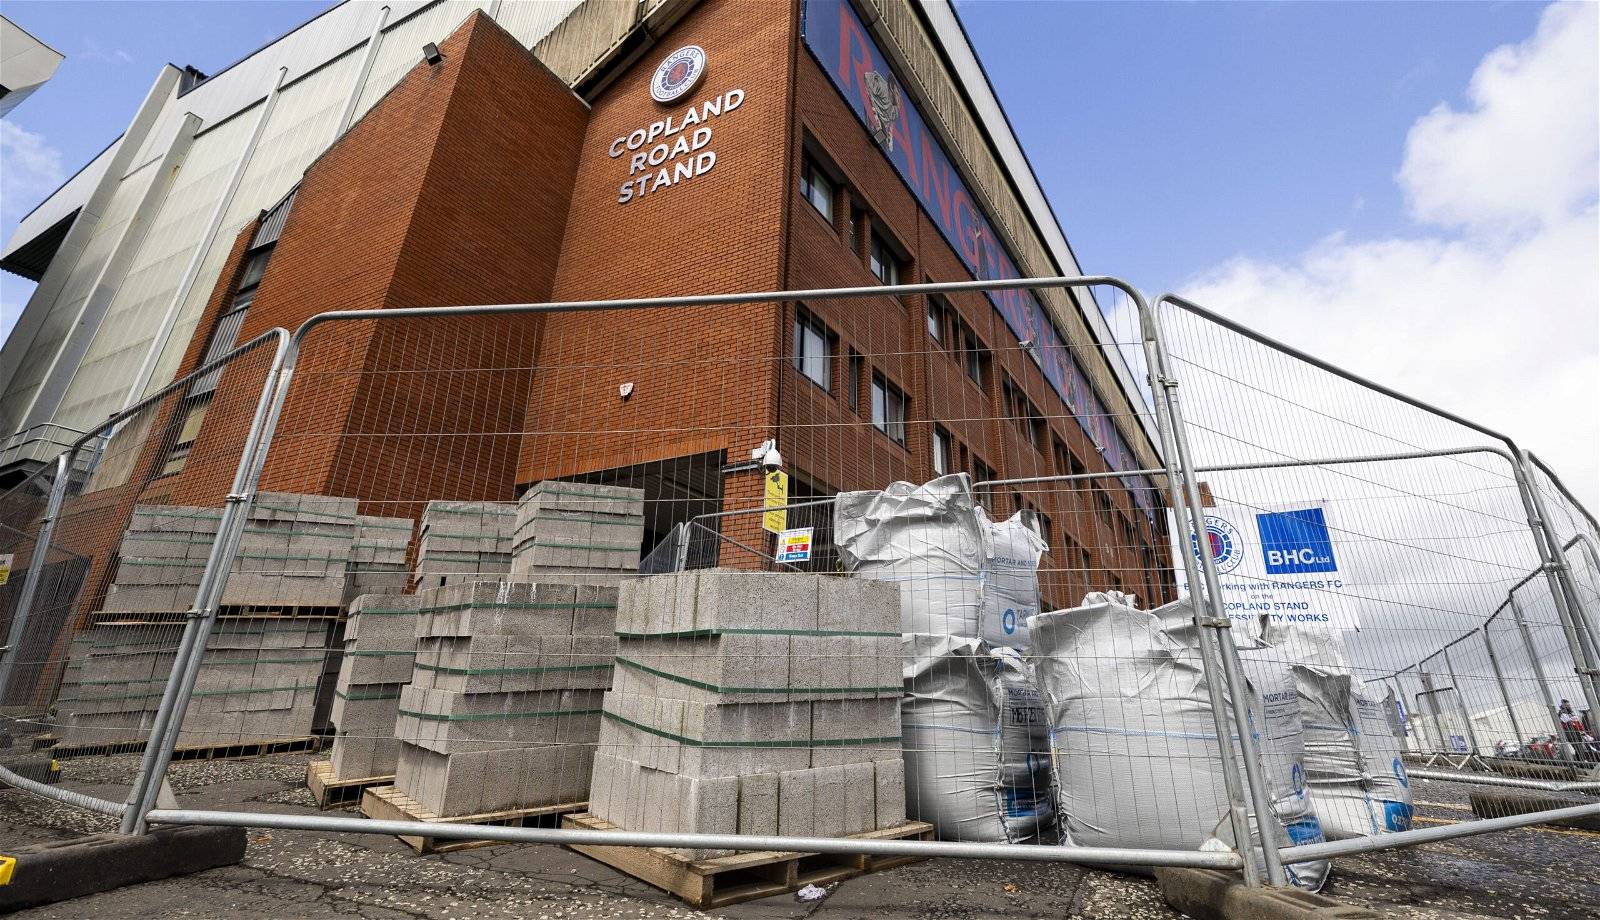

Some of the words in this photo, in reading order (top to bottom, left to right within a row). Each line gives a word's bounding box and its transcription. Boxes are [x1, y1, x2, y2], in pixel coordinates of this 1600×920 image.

[661, 50, 699, 71] RANGERS
[608, 88, 745, 158] COPLAND
[630, 127, 712, 175] ROAD
[618, 151, 717, 203] STAND
[1267, 548, 1315, 566] BHC
[1316, 556, 1330, 564] Ltd
[1249, 581, 1270, 591] with
[1272, 580, 1325, 590] RANGERS
[1327, 579, 1343, 588] FC
[1273, 601, 1309, 610] STAND
[1286, 613, 1329, 622] WORKS
